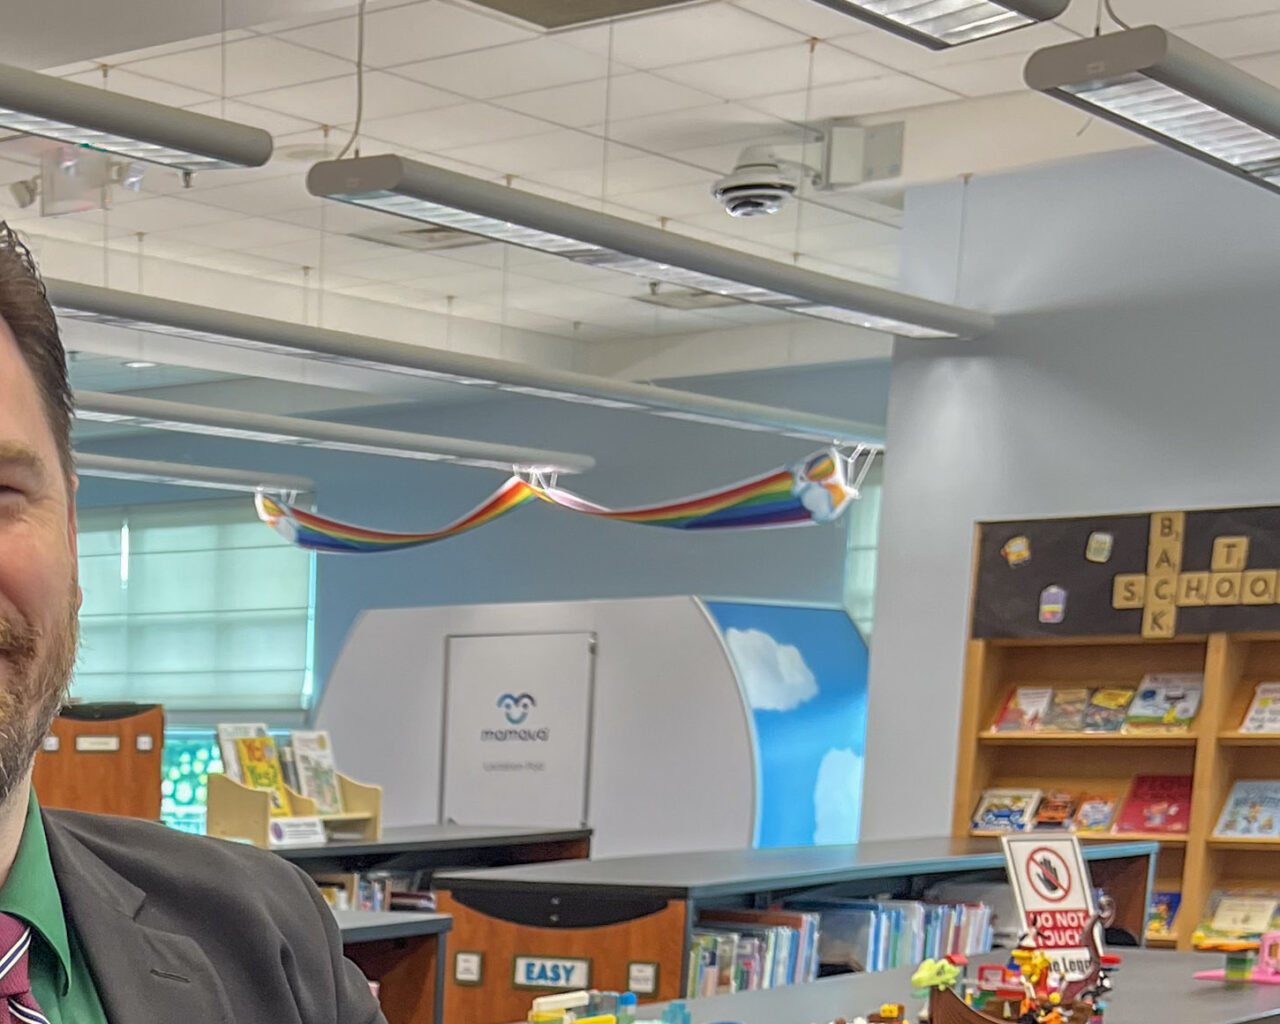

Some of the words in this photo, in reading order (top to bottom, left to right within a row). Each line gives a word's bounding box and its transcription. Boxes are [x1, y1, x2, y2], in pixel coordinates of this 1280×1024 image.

[1124, 577, 1269, 602] SCHOO
[1055, 911, 1086, 928] NOT
[525, 962, 575, 985] EASY
